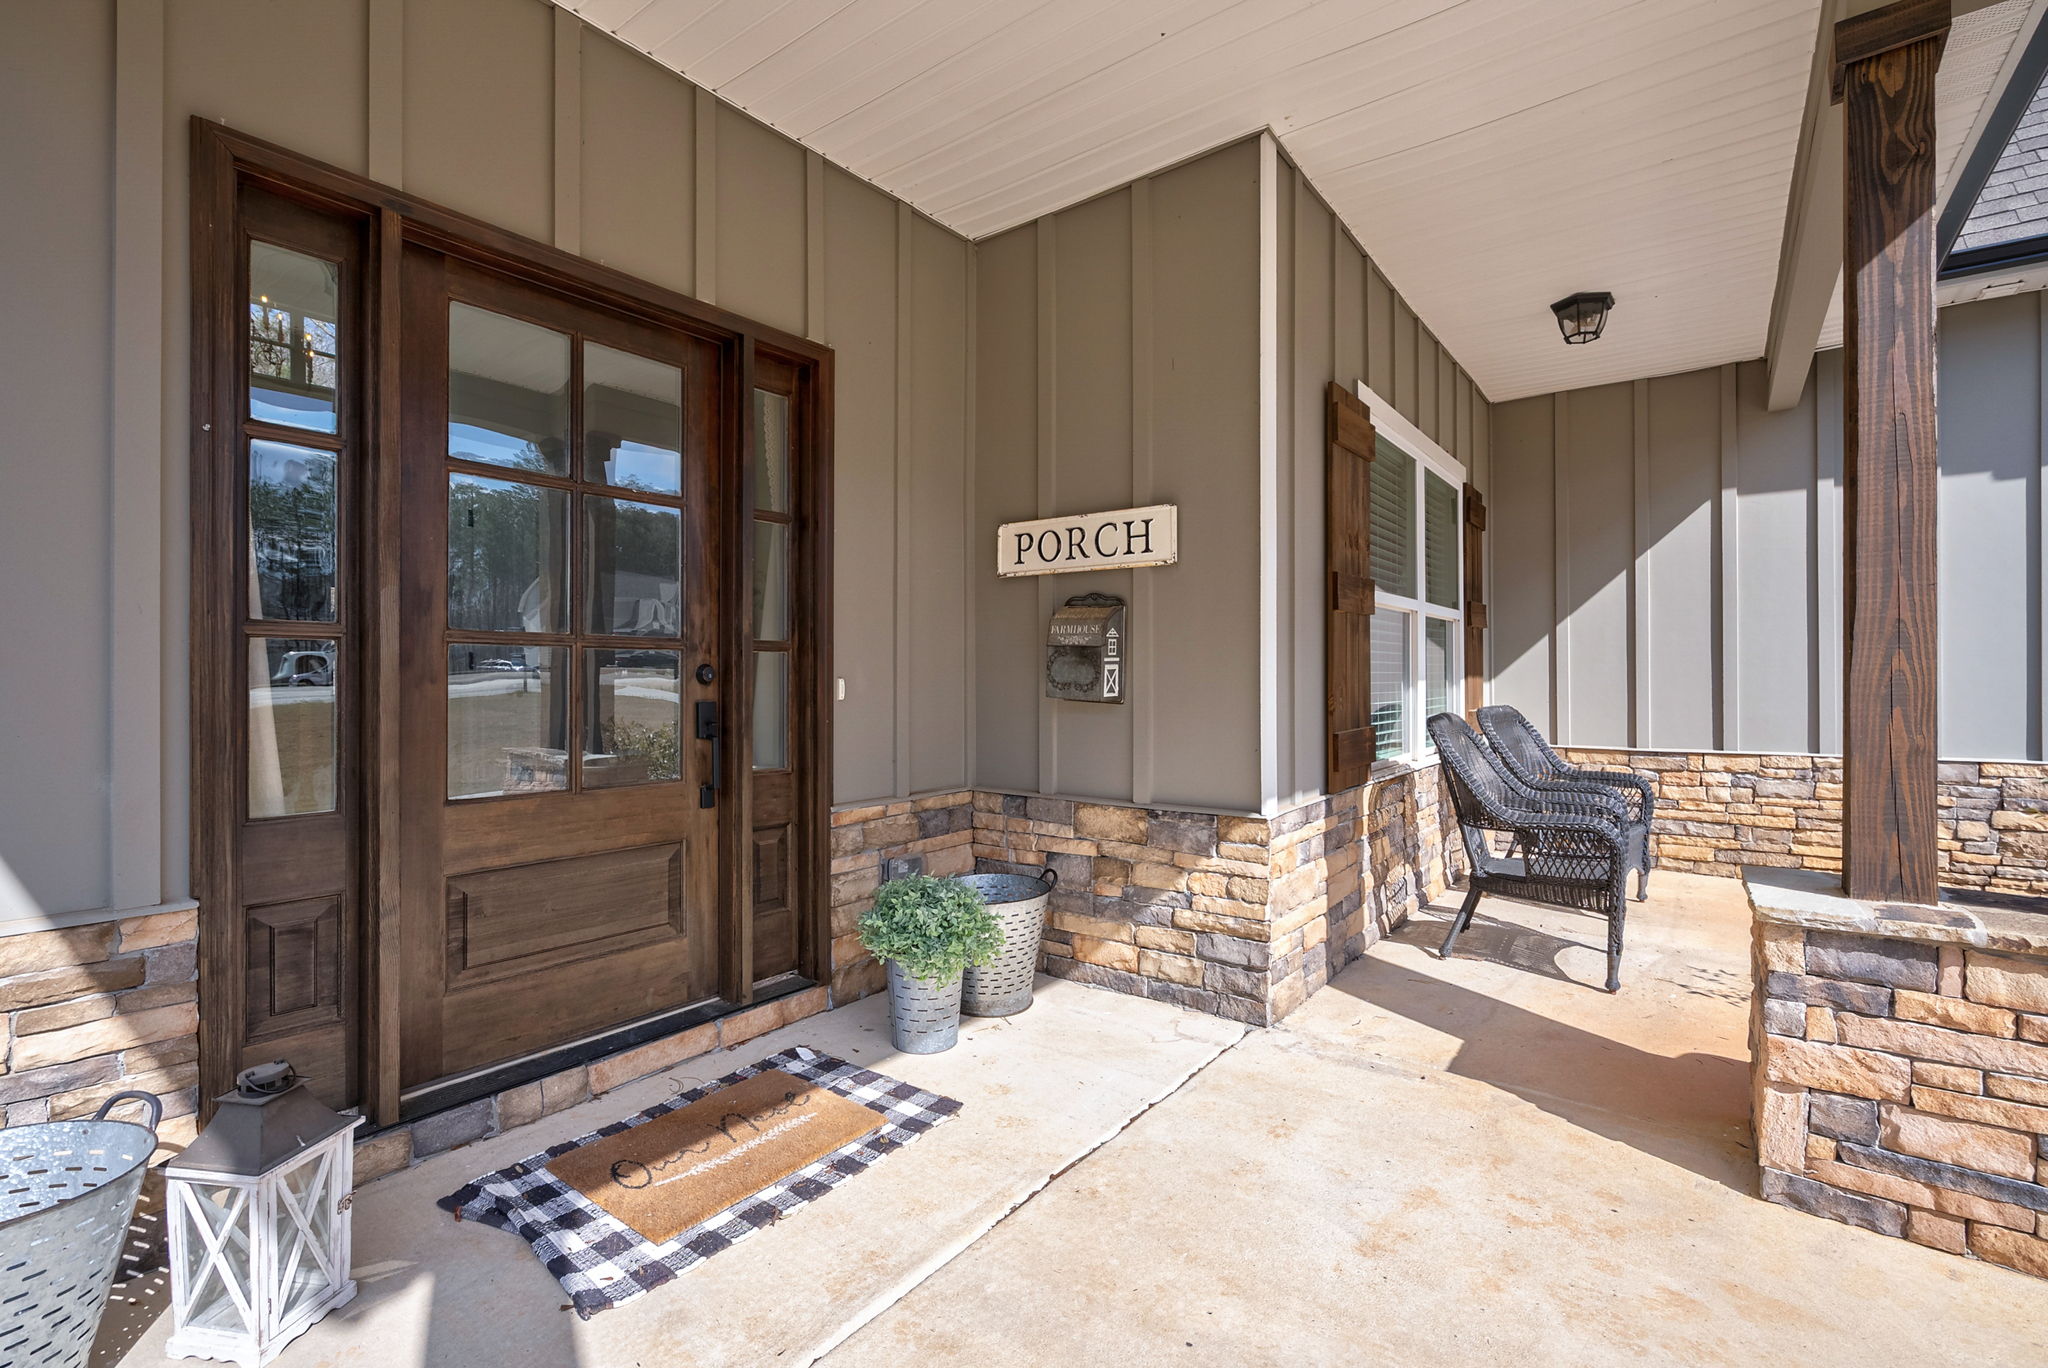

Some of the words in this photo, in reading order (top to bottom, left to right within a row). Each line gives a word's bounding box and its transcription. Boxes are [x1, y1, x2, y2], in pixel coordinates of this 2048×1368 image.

[1014, 518, 1154, 565] PORCH
[1050, 624, 1101, 635] FARMHOUSE
[610, 1142, 710, 1190] Our
